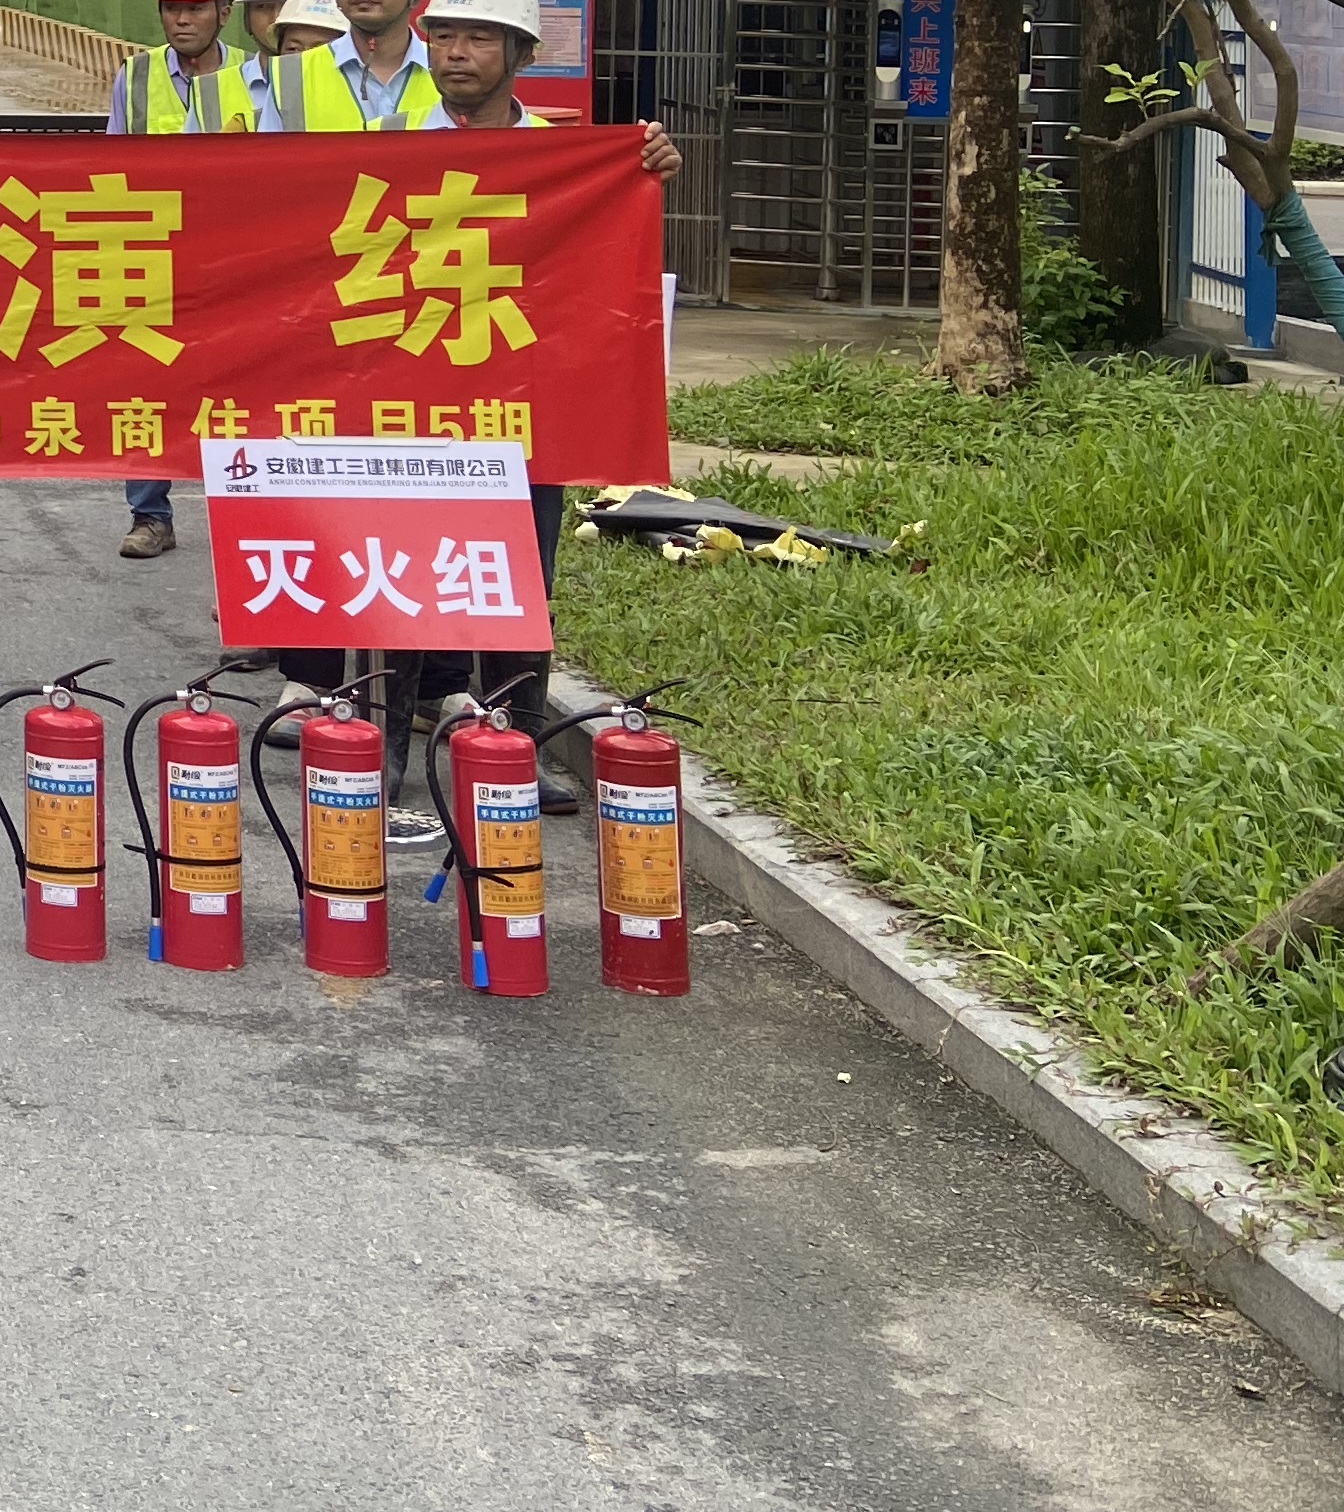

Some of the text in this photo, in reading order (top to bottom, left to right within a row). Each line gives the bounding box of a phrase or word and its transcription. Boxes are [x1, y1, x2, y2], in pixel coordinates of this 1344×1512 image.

[265, 457, 506, 477] 安徽建工三建集团有限公司
[238, 536, 525, 617] 灭火组
